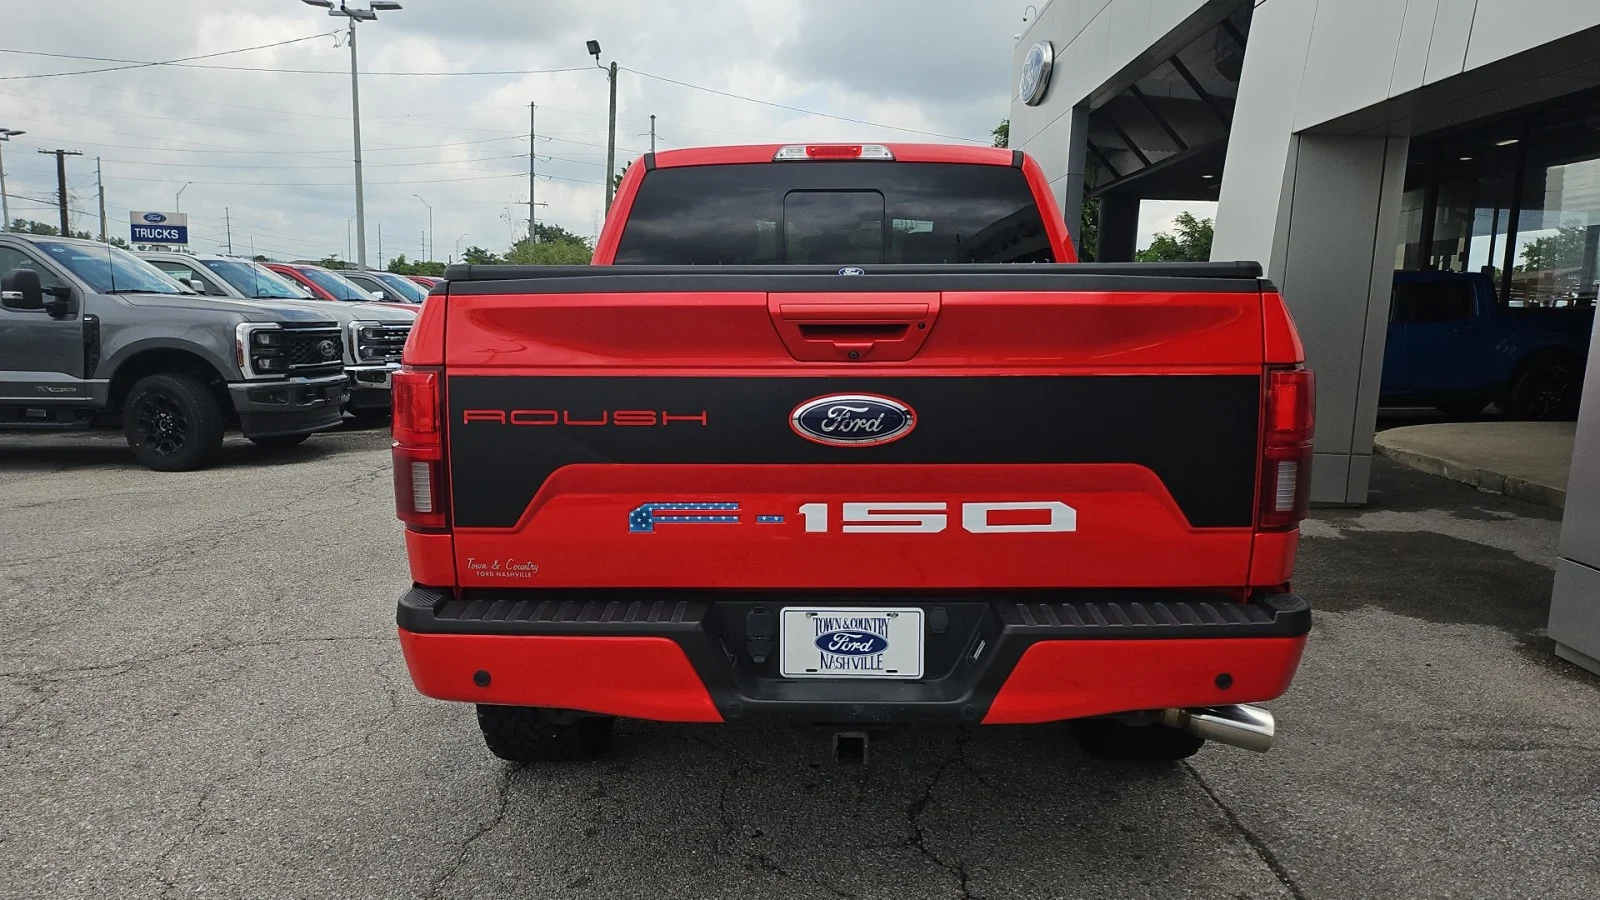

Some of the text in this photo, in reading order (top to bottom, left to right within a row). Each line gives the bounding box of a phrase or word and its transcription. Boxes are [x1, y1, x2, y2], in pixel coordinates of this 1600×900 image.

[134, 228, 179, 239] TRUCKS
[463, 409, 707, 426] ROUSH
[821, 405, 885, 432] Ford
[628, 501, 1077, 534] F-150
[467, 557, 539, 574] Town & Country
[812, 617, 891, 640] TOWN & COUNTRY
[829, 632, 873, 652] Ford
[820, 652, 883, 670] NASHVILLE
